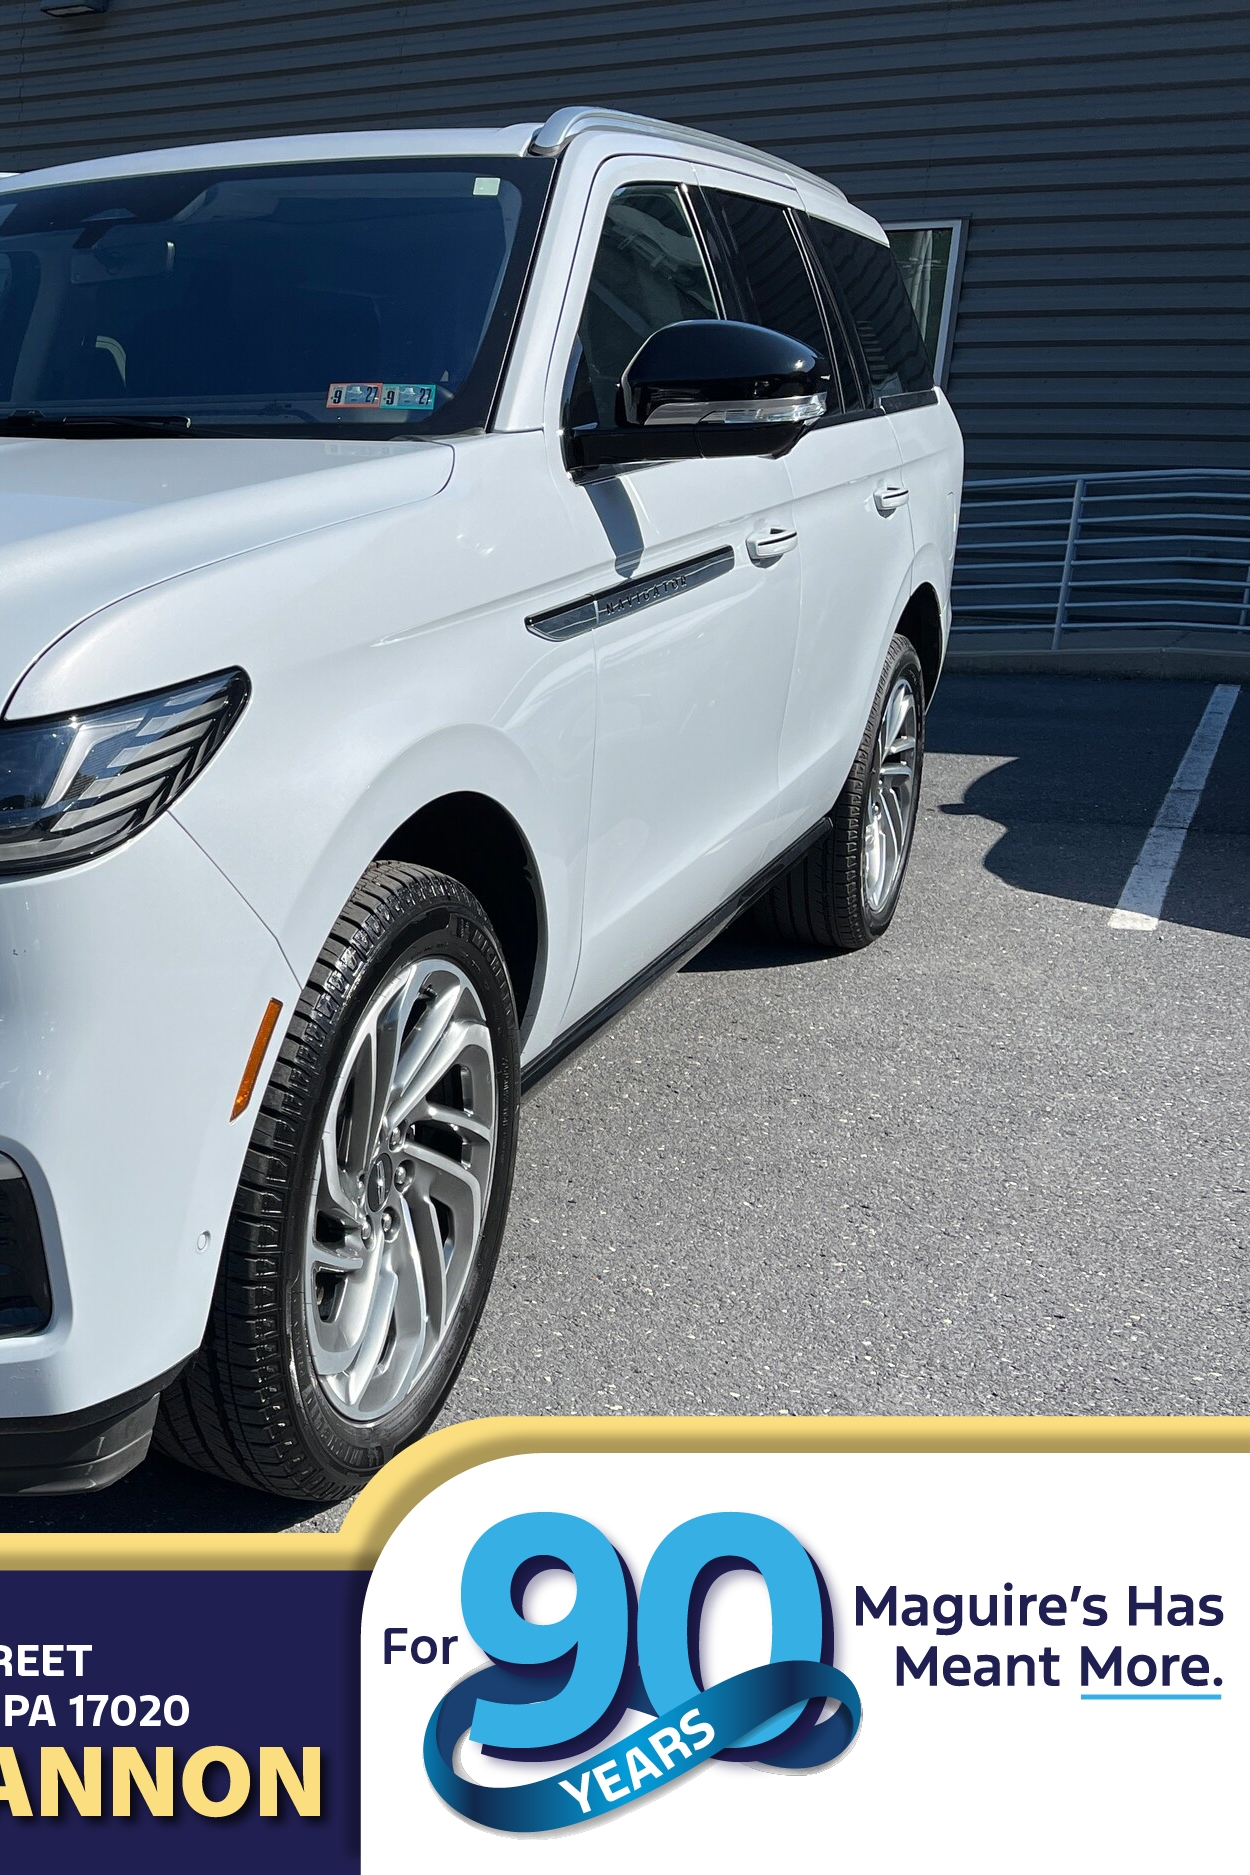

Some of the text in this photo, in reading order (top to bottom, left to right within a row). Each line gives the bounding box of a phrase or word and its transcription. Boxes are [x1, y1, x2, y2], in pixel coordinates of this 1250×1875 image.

[332, 386, 379, 405] 9 27
[385, 387, 432, 406] 9 27
[605, 575, 688, 616] NAVIGATOR
